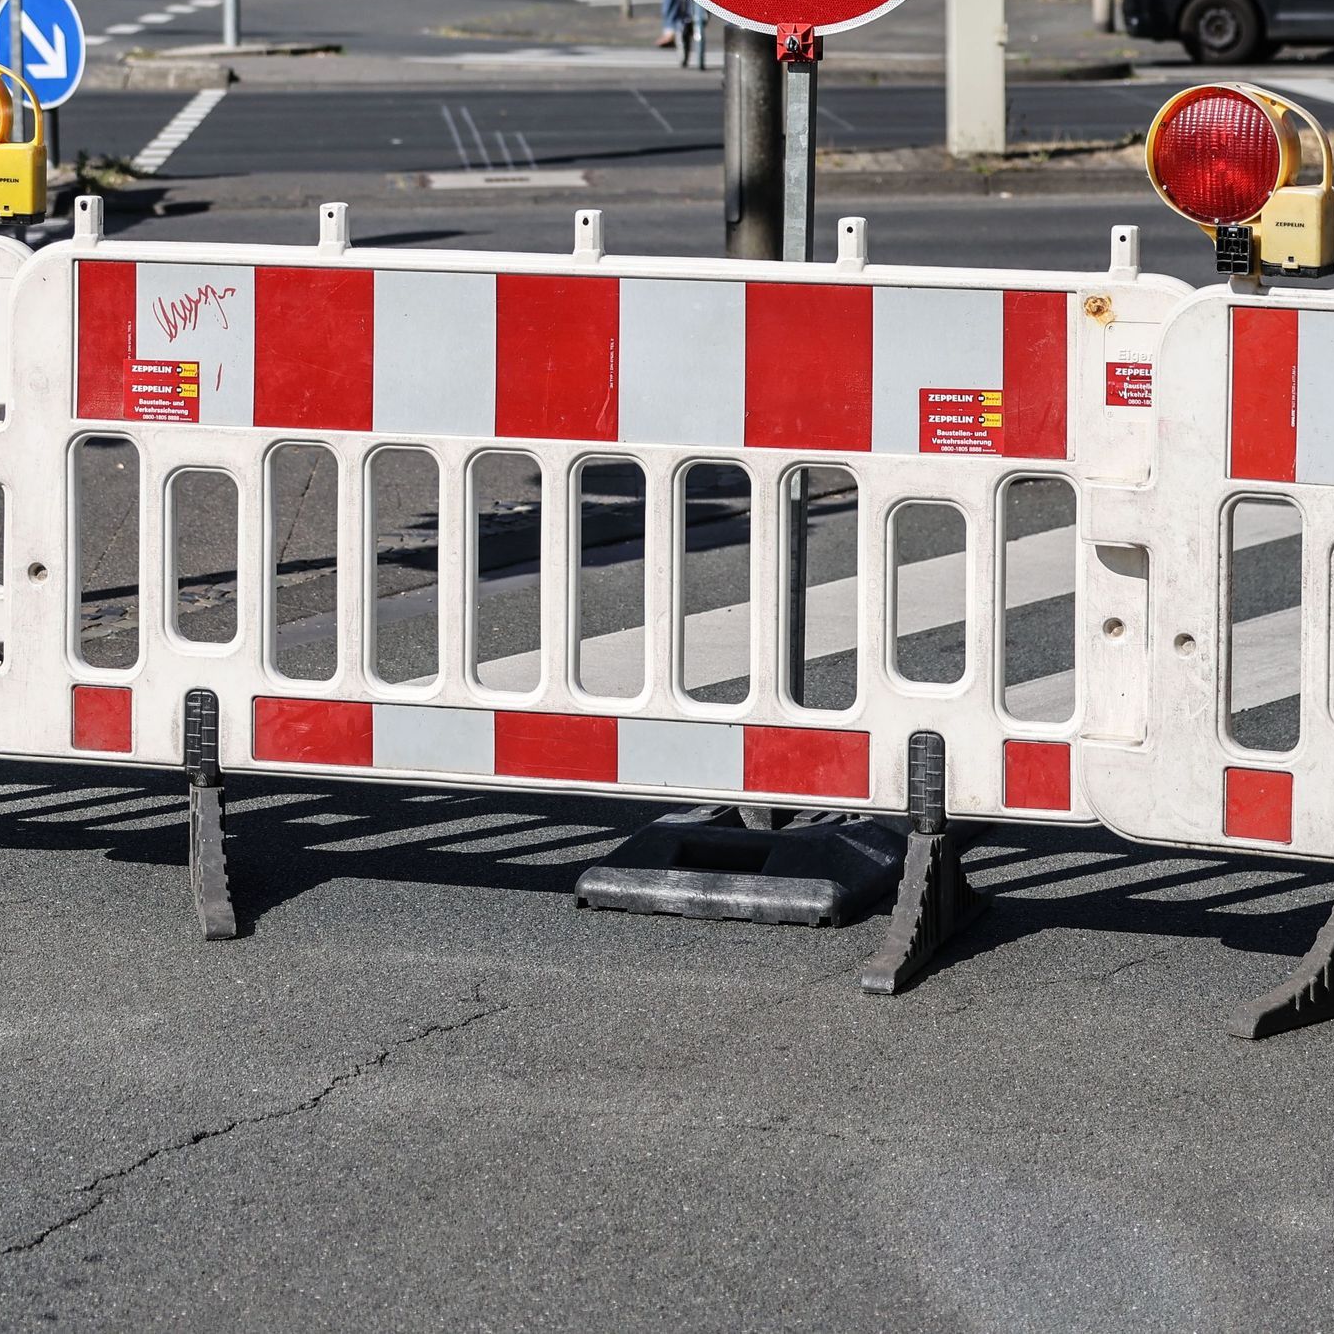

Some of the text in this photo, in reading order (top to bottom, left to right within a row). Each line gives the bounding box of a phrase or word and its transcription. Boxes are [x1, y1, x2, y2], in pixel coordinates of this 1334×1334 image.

[131, 364, 173, 374] ZEPPELIN
[131, 384, 173, 394] ZEPPELIN
[139, 398, 172, 406] Baustellen-
[928, 394, 974, 403] ZEPPELIN
[134, 405, 189, 416] Verkehrssicherung
[928, 415, 974, 424] ZEPPELIN
[936, 429, 988, 438] Baustellen- und
[932, 437, 992, 447] Verkehrssicherung
